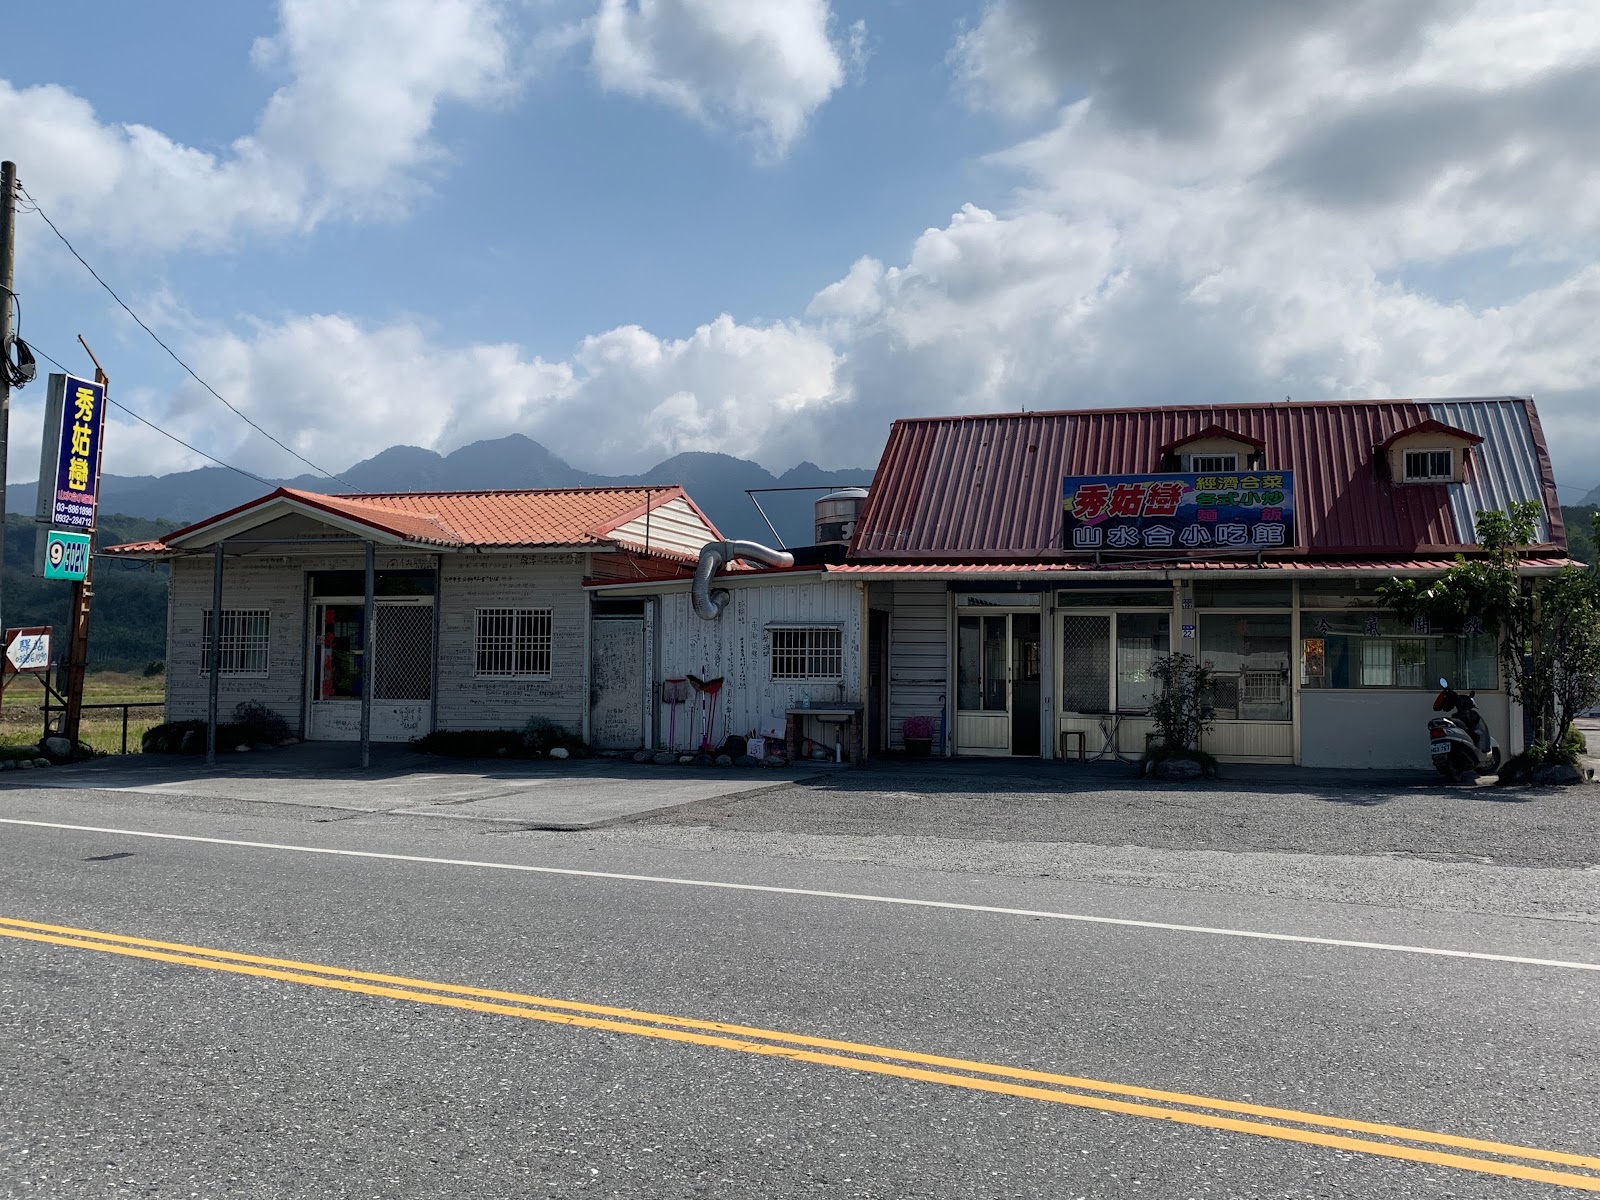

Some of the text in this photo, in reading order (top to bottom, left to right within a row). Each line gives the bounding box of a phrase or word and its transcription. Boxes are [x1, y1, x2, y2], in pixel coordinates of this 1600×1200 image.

[68, 387, 94, 491] 秀姑巒
[1195, 474, 1283, 491] 經濟合菜
[1072, 483, 1184, 519] 秀姑巒
[1195, 492, 1284, 506] 各式小炒
[1072, 523, 1287, 547] 山水合小吃館
[51, 543, 63, 564] 9
[64, 542, 87, 573] 302K
[1183, 630, 1192, 638] 22
[1315, 616, 1485, 638] 冷氣開放
